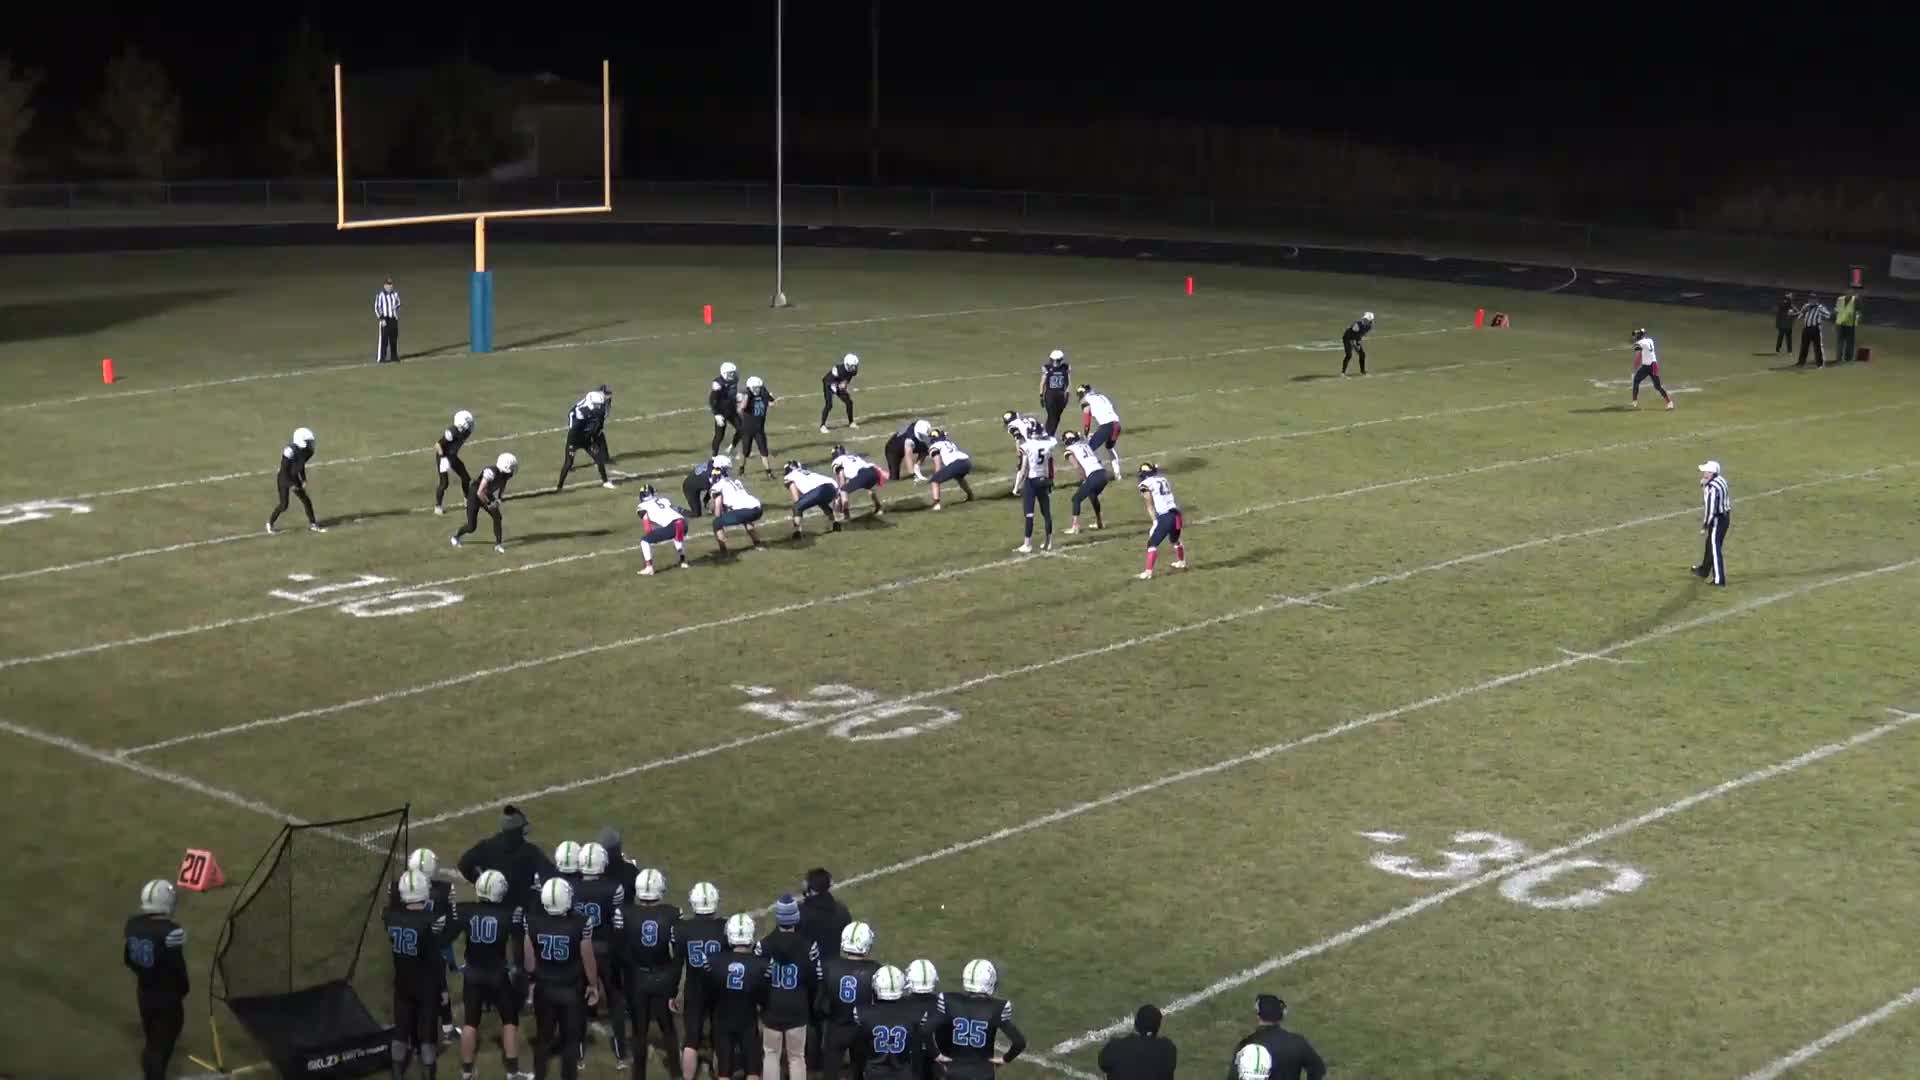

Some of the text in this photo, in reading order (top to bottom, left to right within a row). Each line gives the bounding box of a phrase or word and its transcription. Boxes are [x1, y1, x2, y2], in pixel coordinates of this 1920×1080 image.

[1037, 448, 1045, 464] 5
[268, 574, 464, 617] 10
[735, 684, 962, 743] 20
[180, 854, 207, 885] 20
[1368, 830, 1650, 909] 30
[387, 926, 418, 957] 72
[469, 915, 498, 944] 10
[641, 920, 658, 947] 9
[537, 934, 570, 960] 75
[726, 962, 745, 990] 2
[771, 963, 798, 990] 18
[839, 975, 857, 1003] 6
[872, 1025, 907, 1054] 23
[952, 1017, 988, 1049] 25
